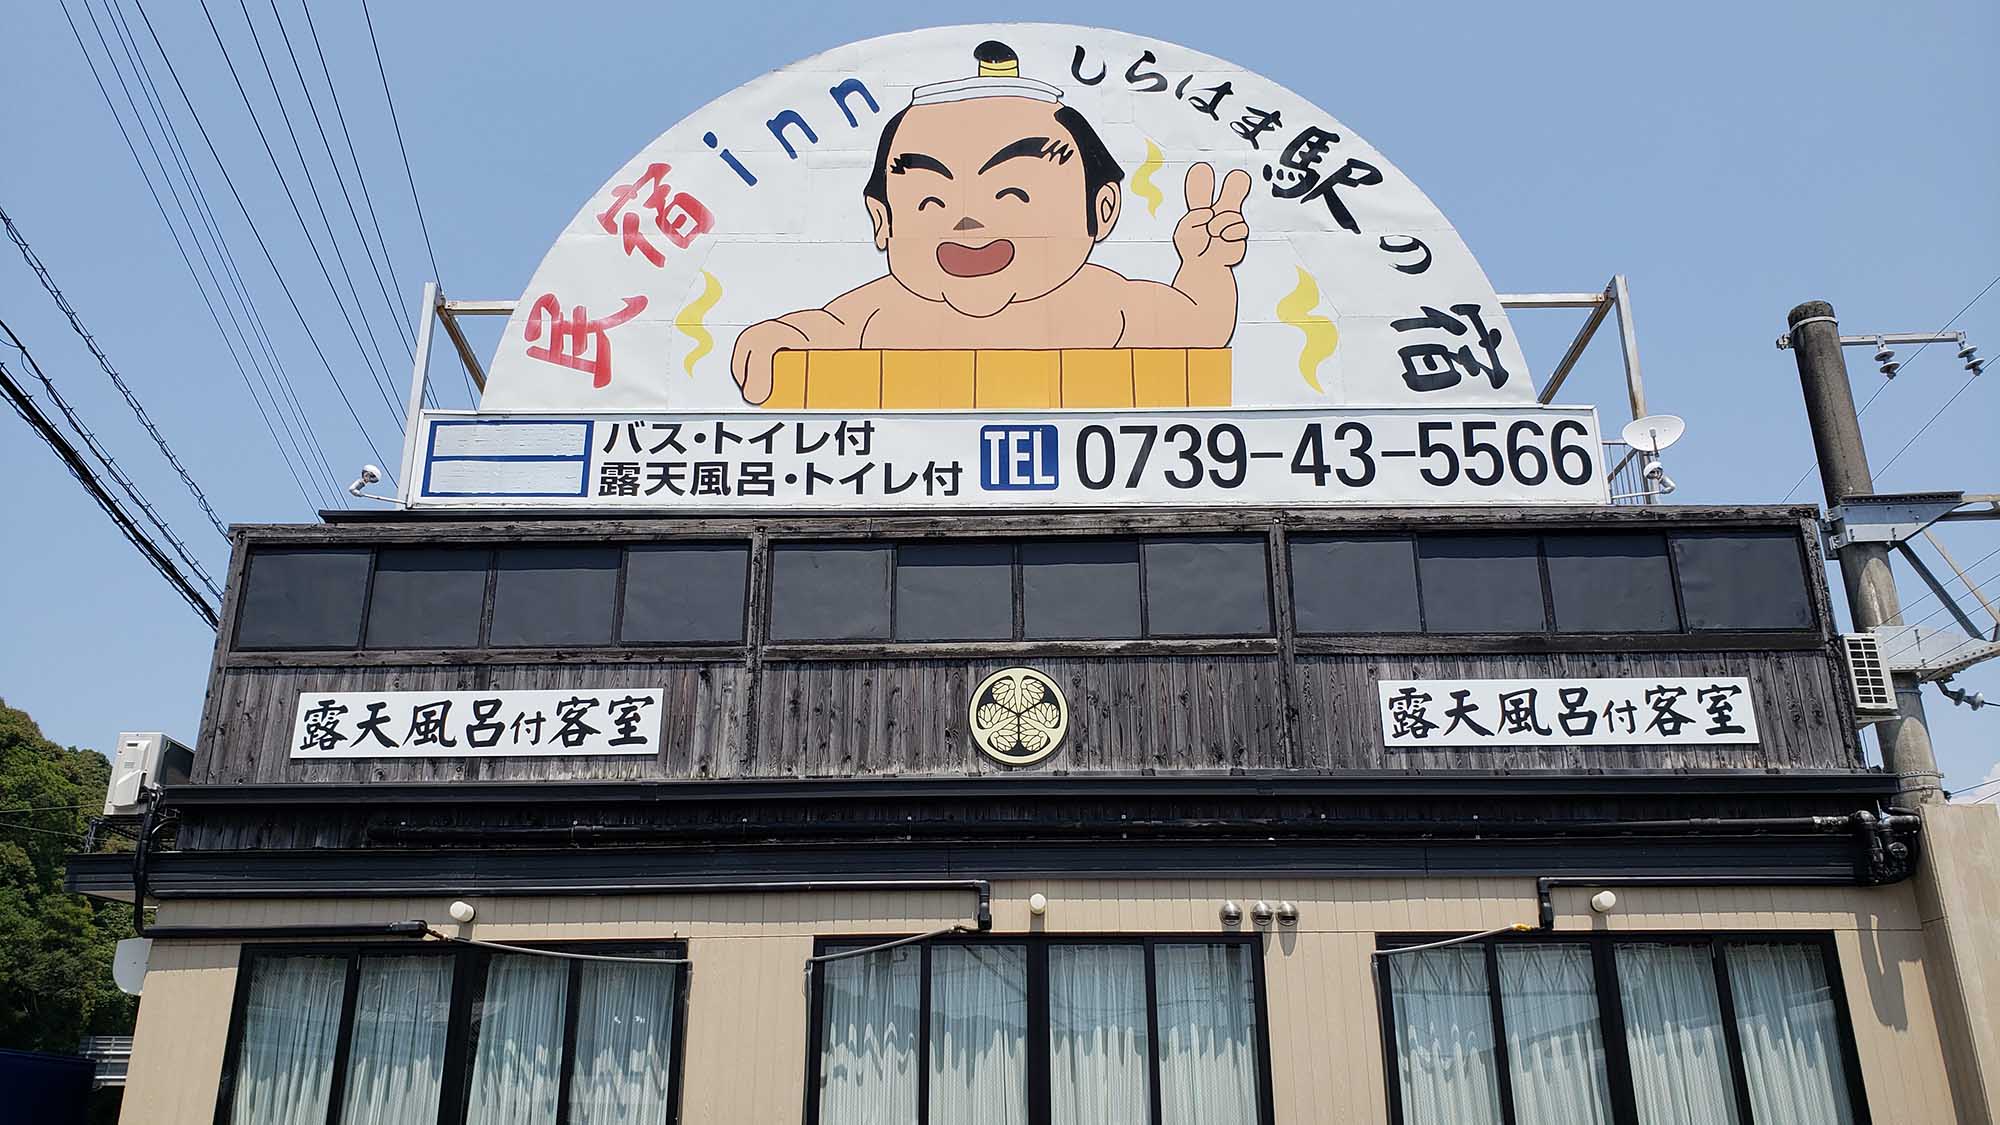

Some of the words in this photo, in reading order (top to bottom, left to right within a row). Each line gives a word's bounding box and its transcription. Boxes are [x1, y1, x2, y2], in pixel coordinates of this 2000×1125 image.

[603, 420, 875, 456] バス・トイレ付
[983, 429, 1056, 487] TEL
[1076, 420, 1593, 490] 0739-43-5566
[598, 461, 963, 497] 露天風呂・トイレ付
[299, 696, 655, 751] 露天風呂付客室
[1388, 684, 1746, 739] 露天風呂付客室
